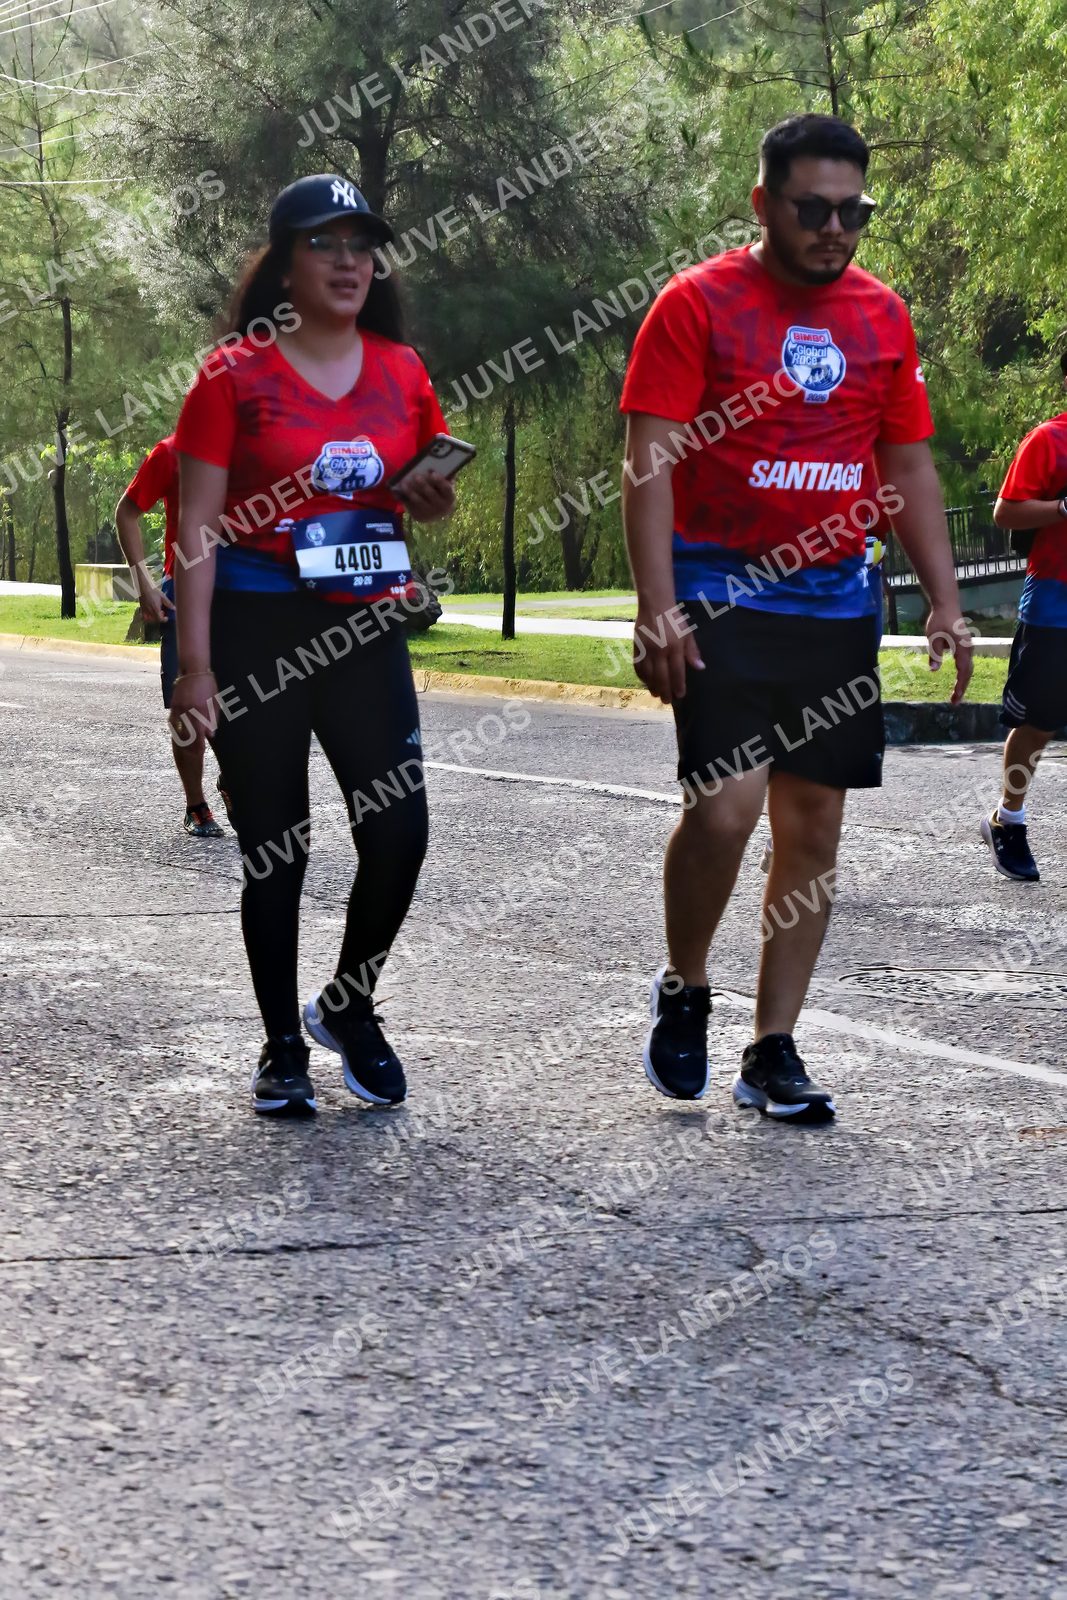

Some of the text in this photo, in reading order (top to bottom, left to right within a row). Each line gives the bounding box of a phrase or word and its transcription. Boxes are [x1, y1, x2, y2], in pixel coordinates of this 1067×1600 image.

[330, 180, 358, 209] NY
[793, 332, 825, 343] BIMBO
[796, 344, 828, 358] Global
[792, 352, 818, 366] Race
[330, 447, 368, 455] BIMBO
[330, 457, 369, 470] Global
[748, 459, 864, 491] SANTIAGO
[335, 544, 383, 572] 4409
